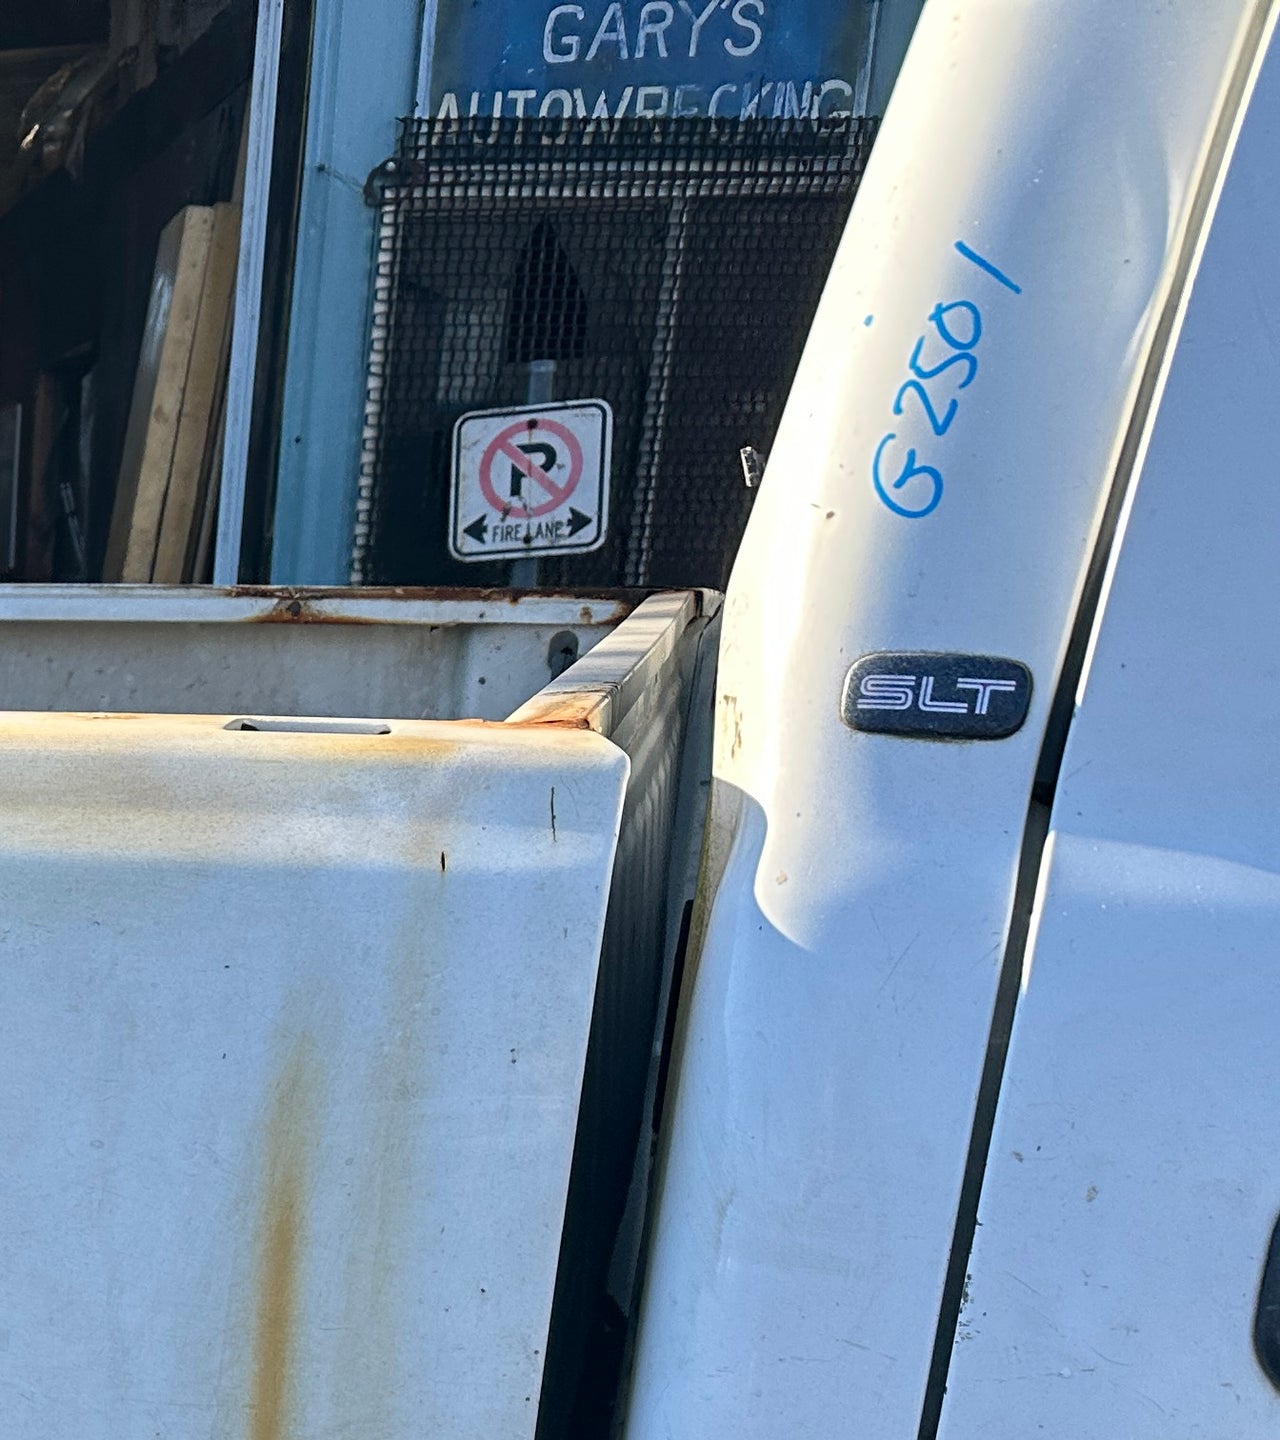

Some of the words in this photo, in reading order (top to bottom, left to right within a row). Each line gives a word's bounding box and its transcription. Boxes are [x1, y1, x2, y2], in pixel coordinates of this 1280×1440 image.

[543, 0, 765, 63] GARY'S
[873, 240, 1022, 519] G2501
[492, 523, 521, 543] FIRE
[857, 675, 1017, 715] SLT
